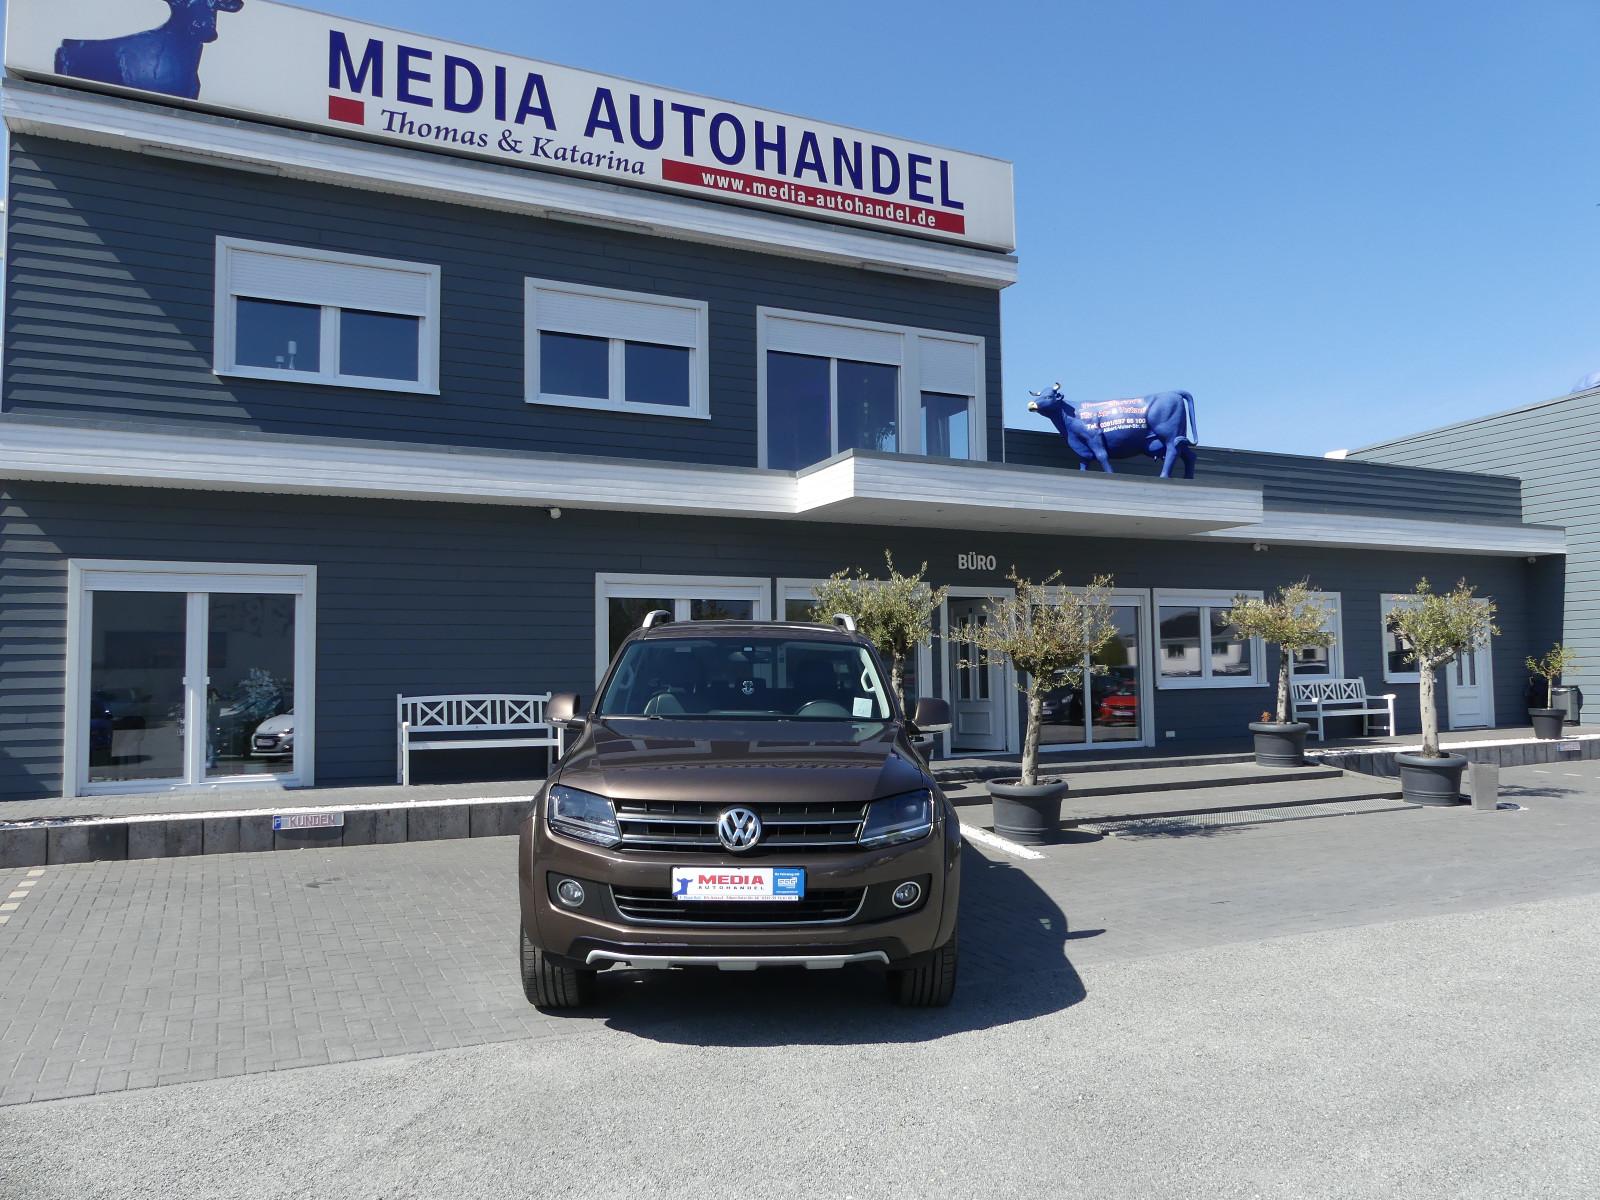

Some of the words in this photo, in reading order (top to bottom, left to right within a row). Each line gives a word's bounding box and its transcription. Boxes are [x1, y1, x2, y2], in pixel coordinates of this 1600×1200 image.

[328, 29, 557, 132] MEDIA
[583, 86, 965, 211] AUTOHANDEL
[380, 109, 489, 148] Thomas
[498, 128, 523, 153] &
[530, 137, 645, 176] Katarina
[701, 172, 937, 228] www.media-autohandel.de
[958, 551, 996, 570] BÜRO
[288, 814, 336, 828] KUNDEN
[698, 875, 764, 885] MEDIA
